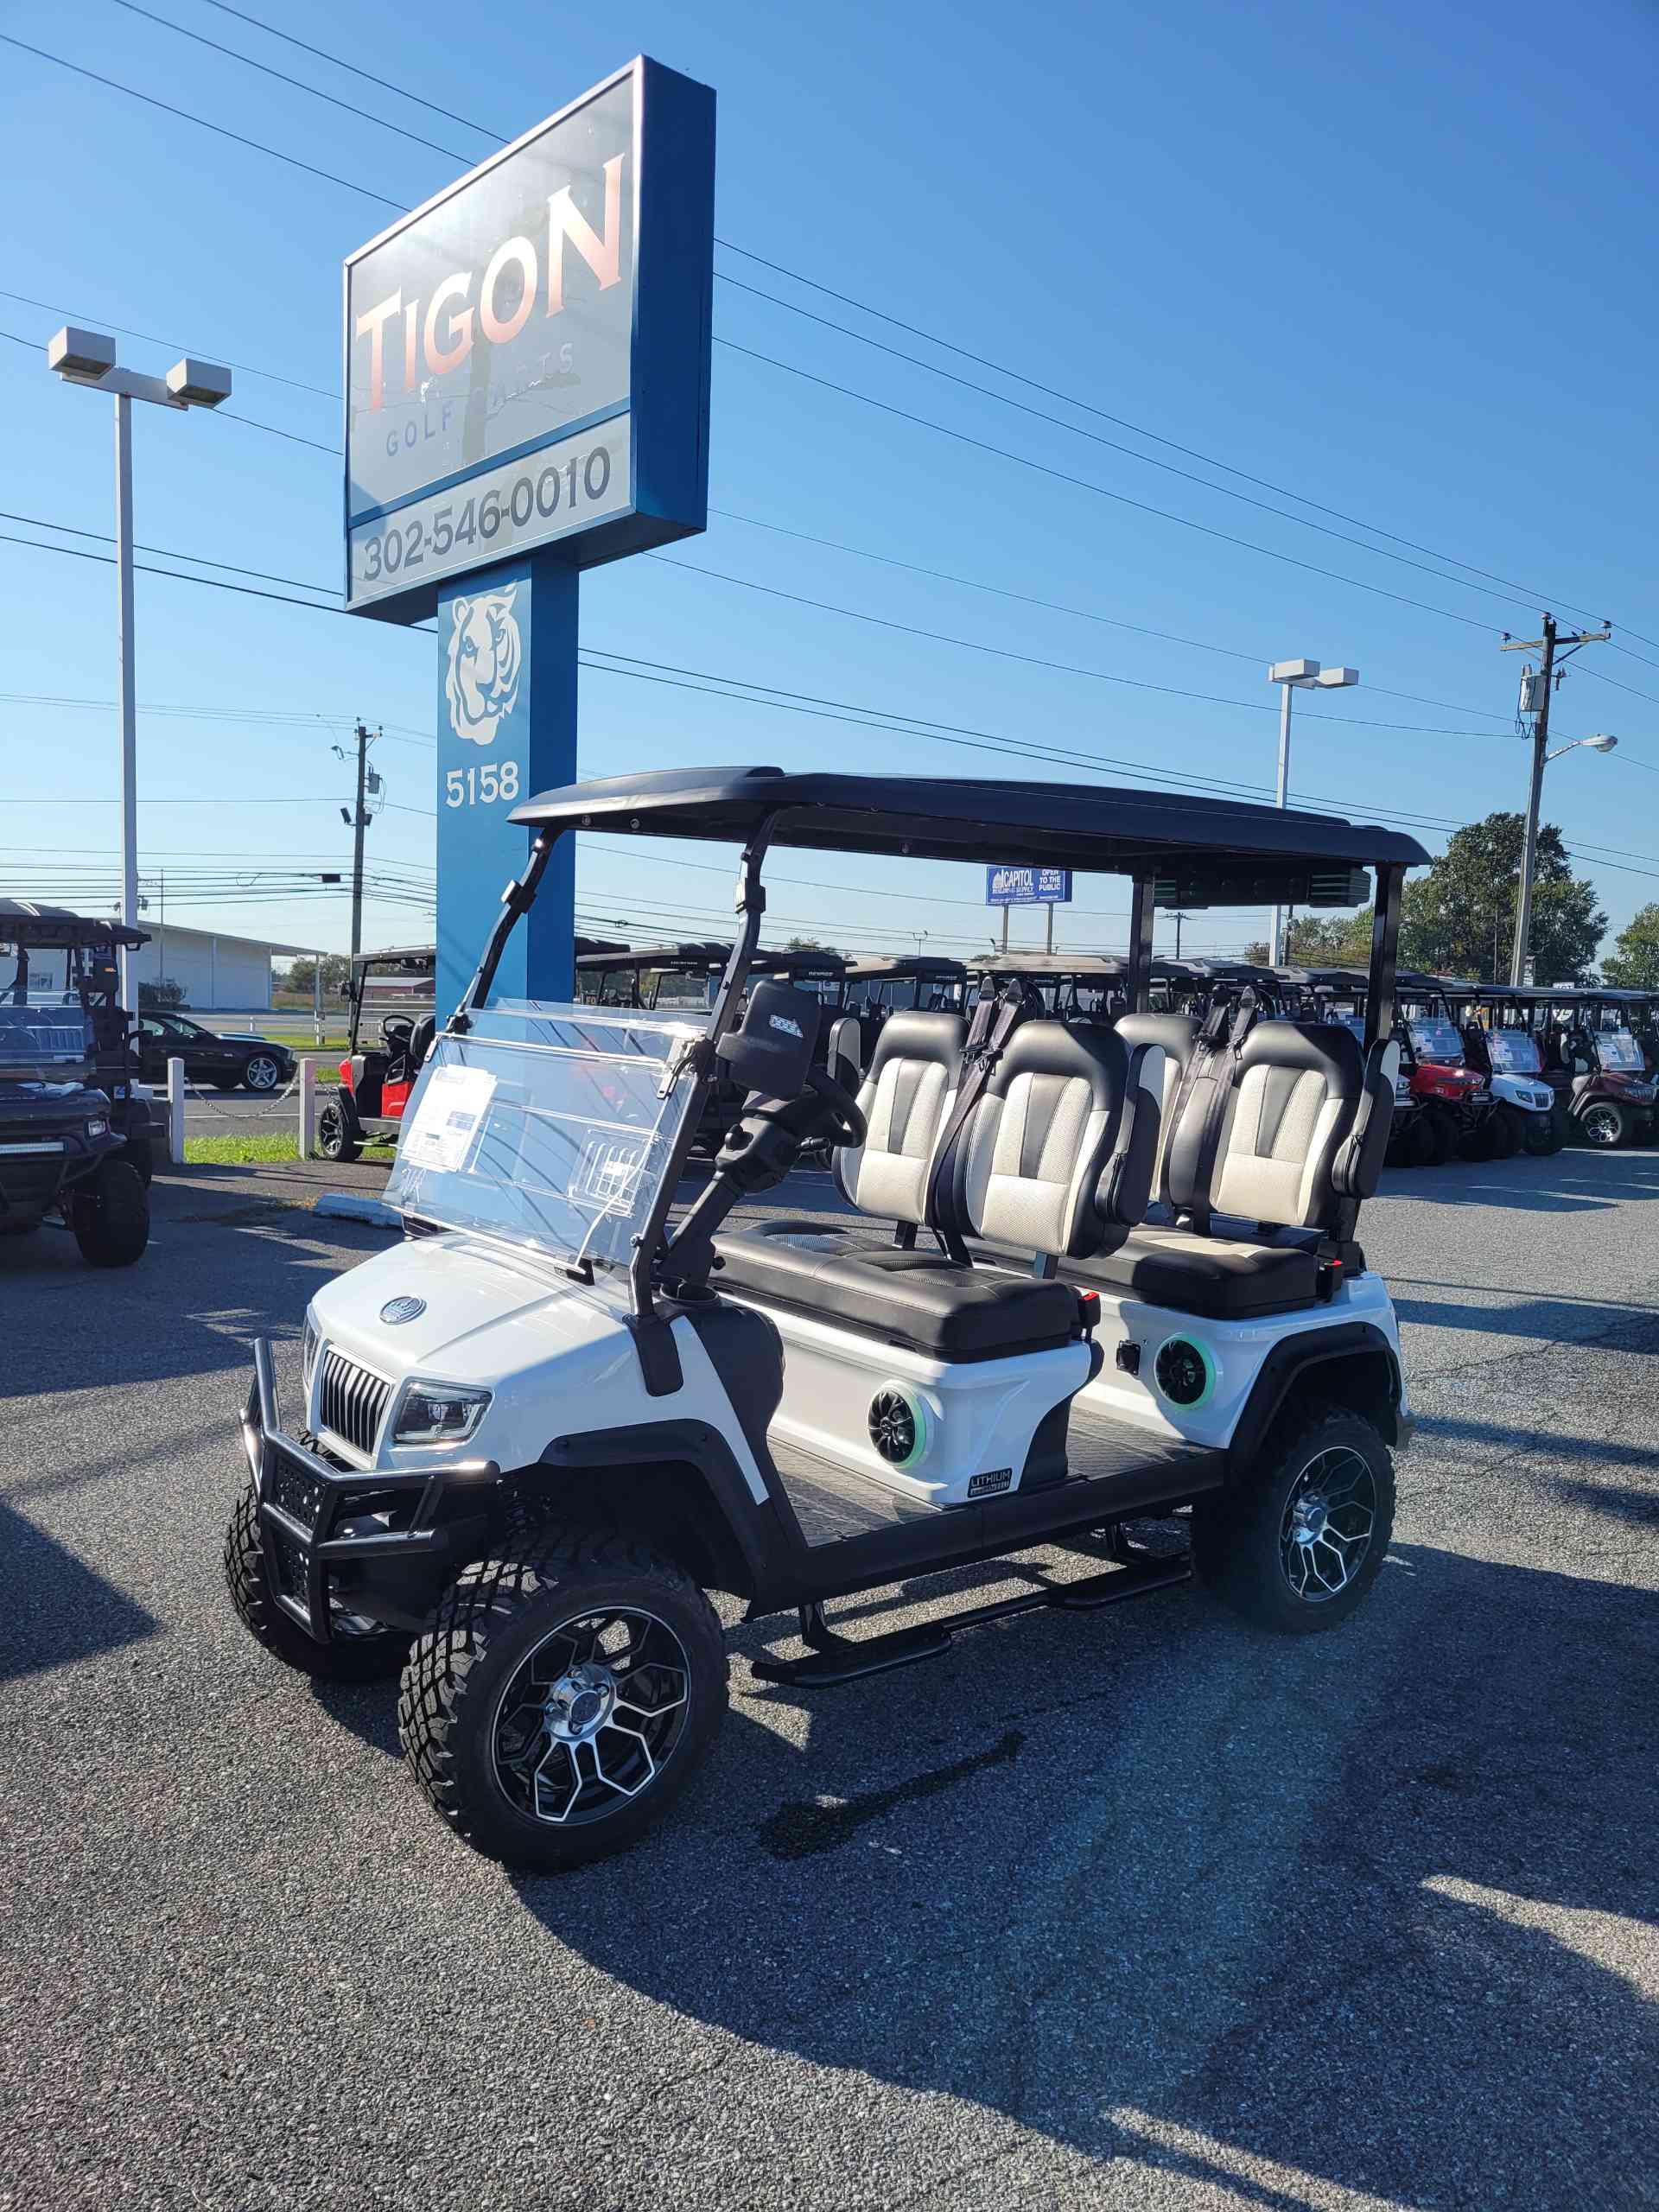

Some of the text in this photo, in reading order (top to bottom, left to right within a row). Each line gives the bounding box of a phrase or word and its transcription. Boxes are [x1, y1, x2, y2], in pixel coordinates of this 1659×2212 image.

[355, 153, 626, 416] TIGON
[386, 400, 455, 457] GOLF
[363, 446, 612, 582] 302-546-0010
[445, 760, 519, 809] 5158
[1004, 869, 1034, 887] CAPITOL
[971, 1471, 1010, 1487] LITHIUM
